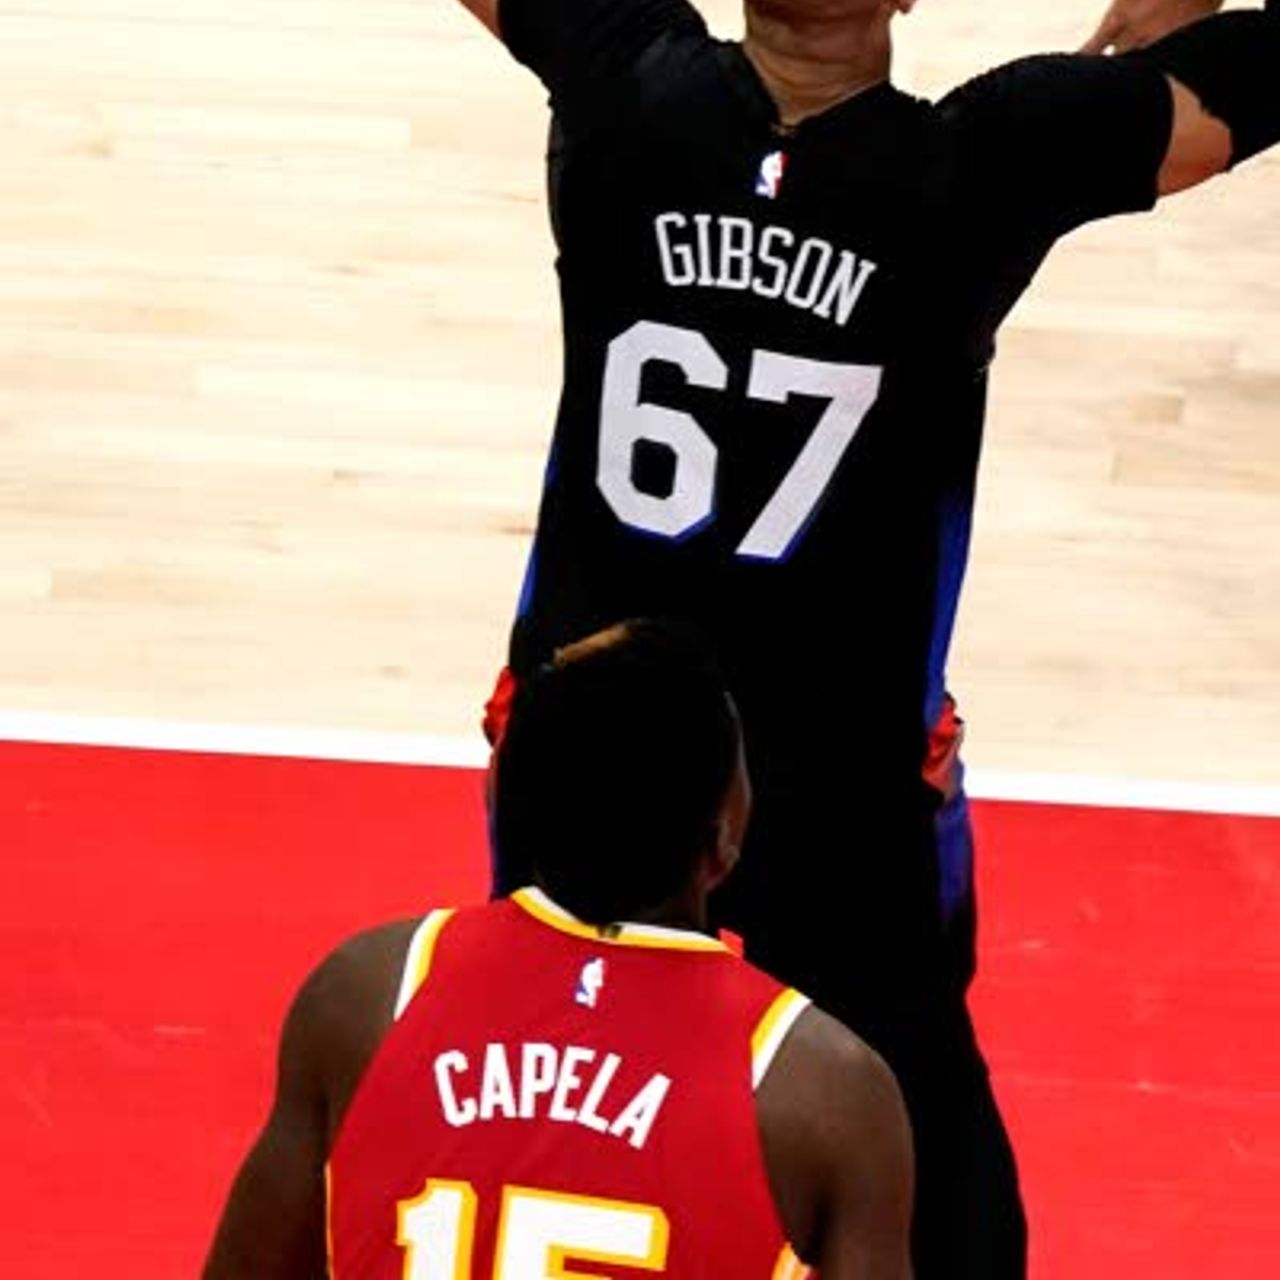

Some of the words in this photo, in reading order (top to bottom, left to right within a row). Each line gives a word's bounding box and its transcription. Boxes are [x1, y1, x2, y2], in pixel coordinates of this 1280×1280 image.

[655, 212, 877, 326] GIBSON
[596, 319, 884, 560] 67
[433, 1042, 671, 1149] CAPELA
